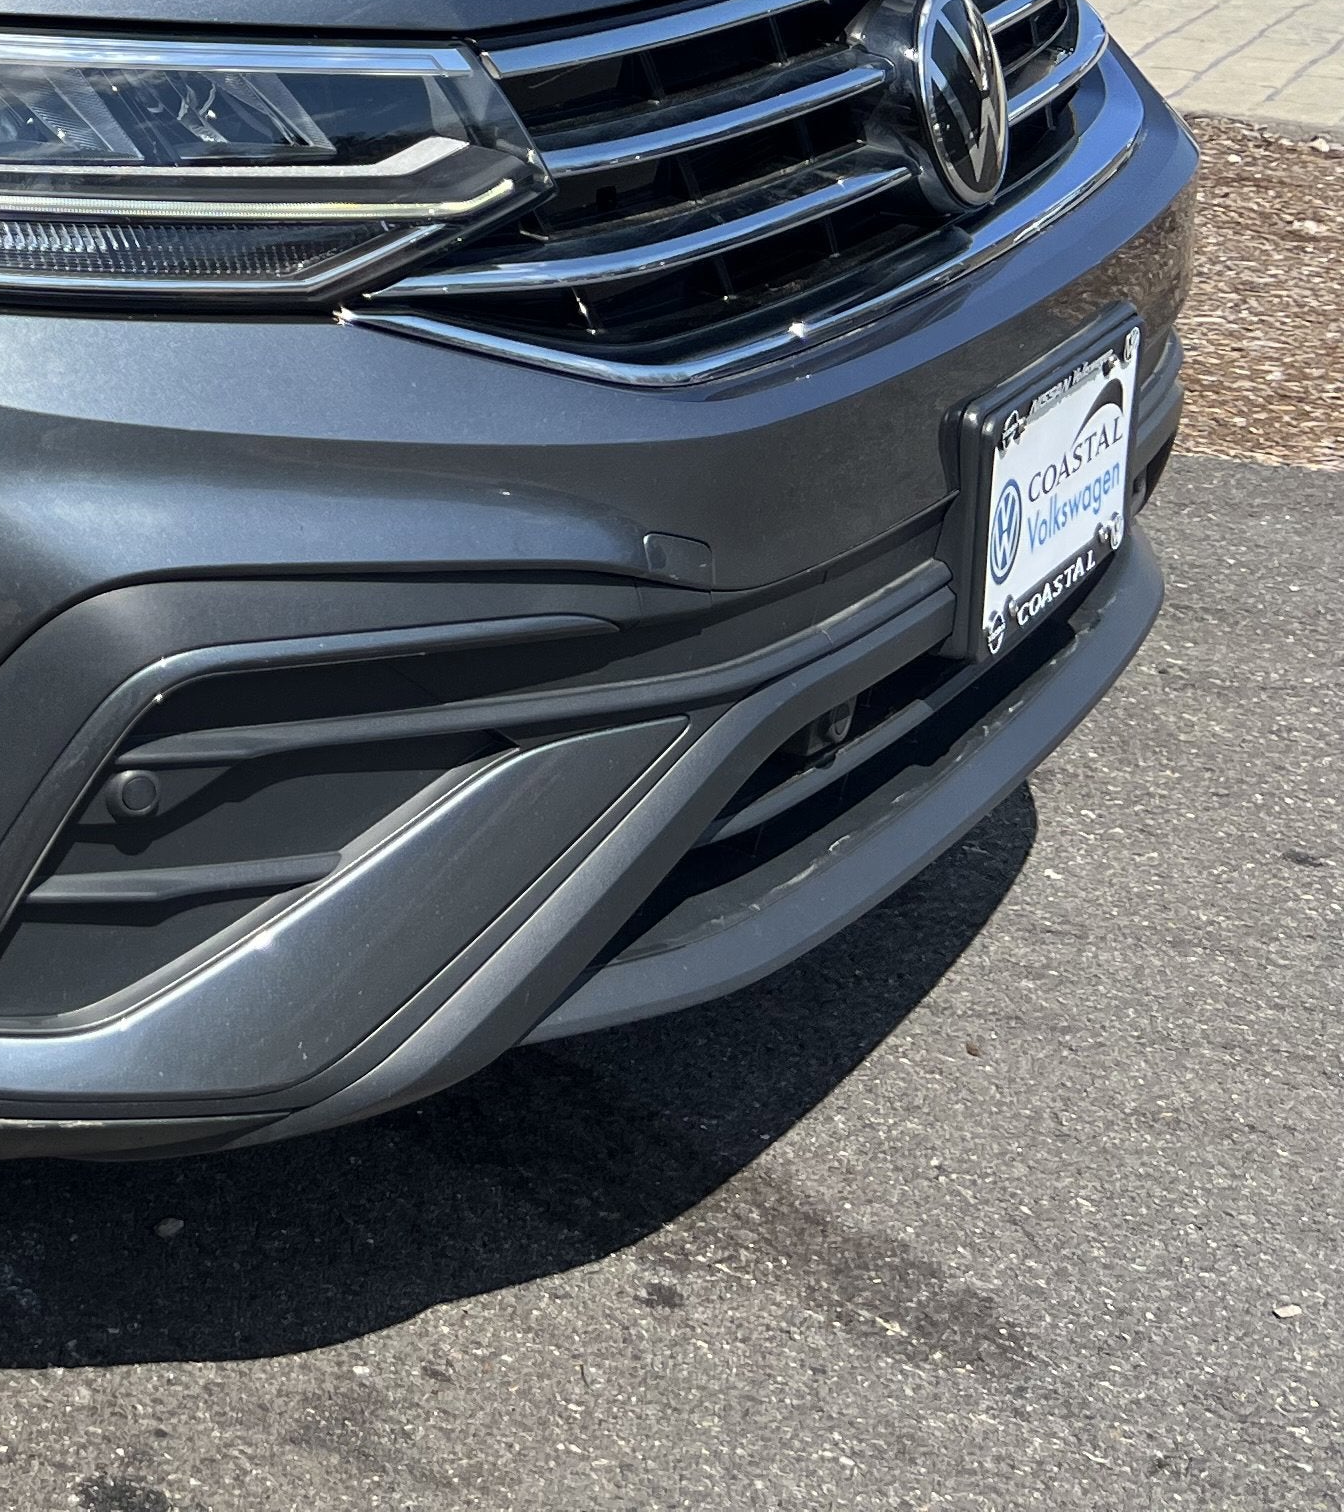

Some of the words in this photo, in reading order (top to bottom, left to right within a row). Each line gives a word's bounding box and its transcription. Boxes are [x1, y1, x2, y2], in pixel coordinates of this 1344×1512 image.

[1027, 415, 1124, 504] COASTAL
[1026, 461, 1120, 555] Volkswagen
[1016, 549, 1097, 627] COASTAL
